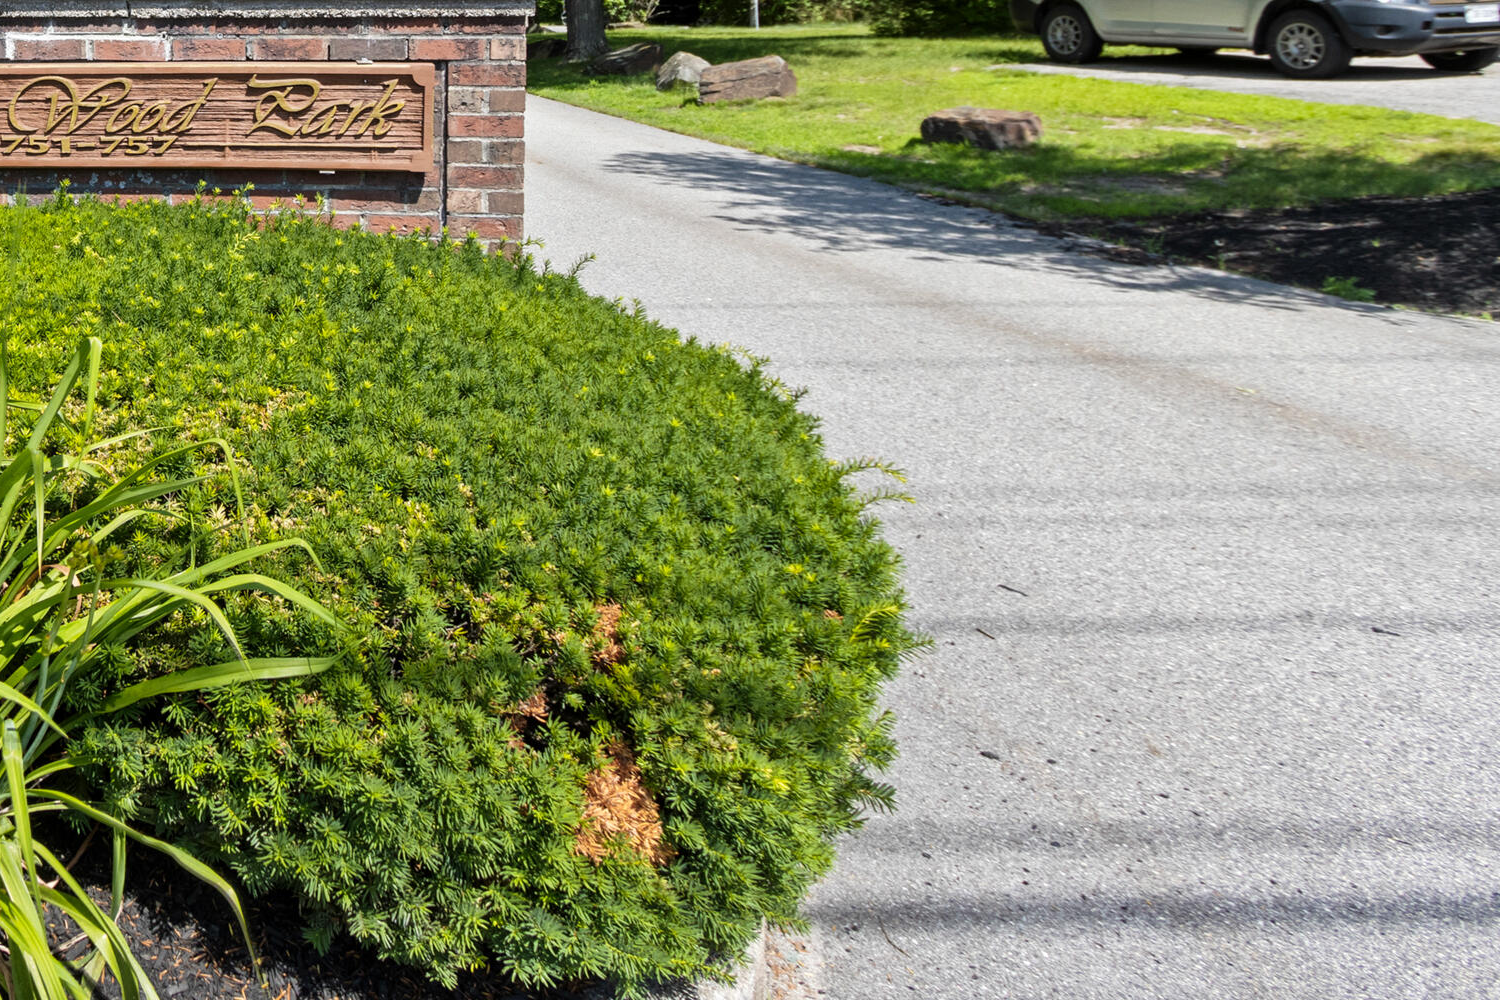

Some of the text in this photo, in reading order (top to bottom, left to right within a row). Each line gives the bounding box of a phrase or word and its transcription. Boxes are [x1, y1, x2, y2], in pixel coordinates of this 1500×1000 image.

[8, 75, 218, 134] Wood
[246, 74, 406, 136] Park
[1, 135, 178, 155] 751-757
